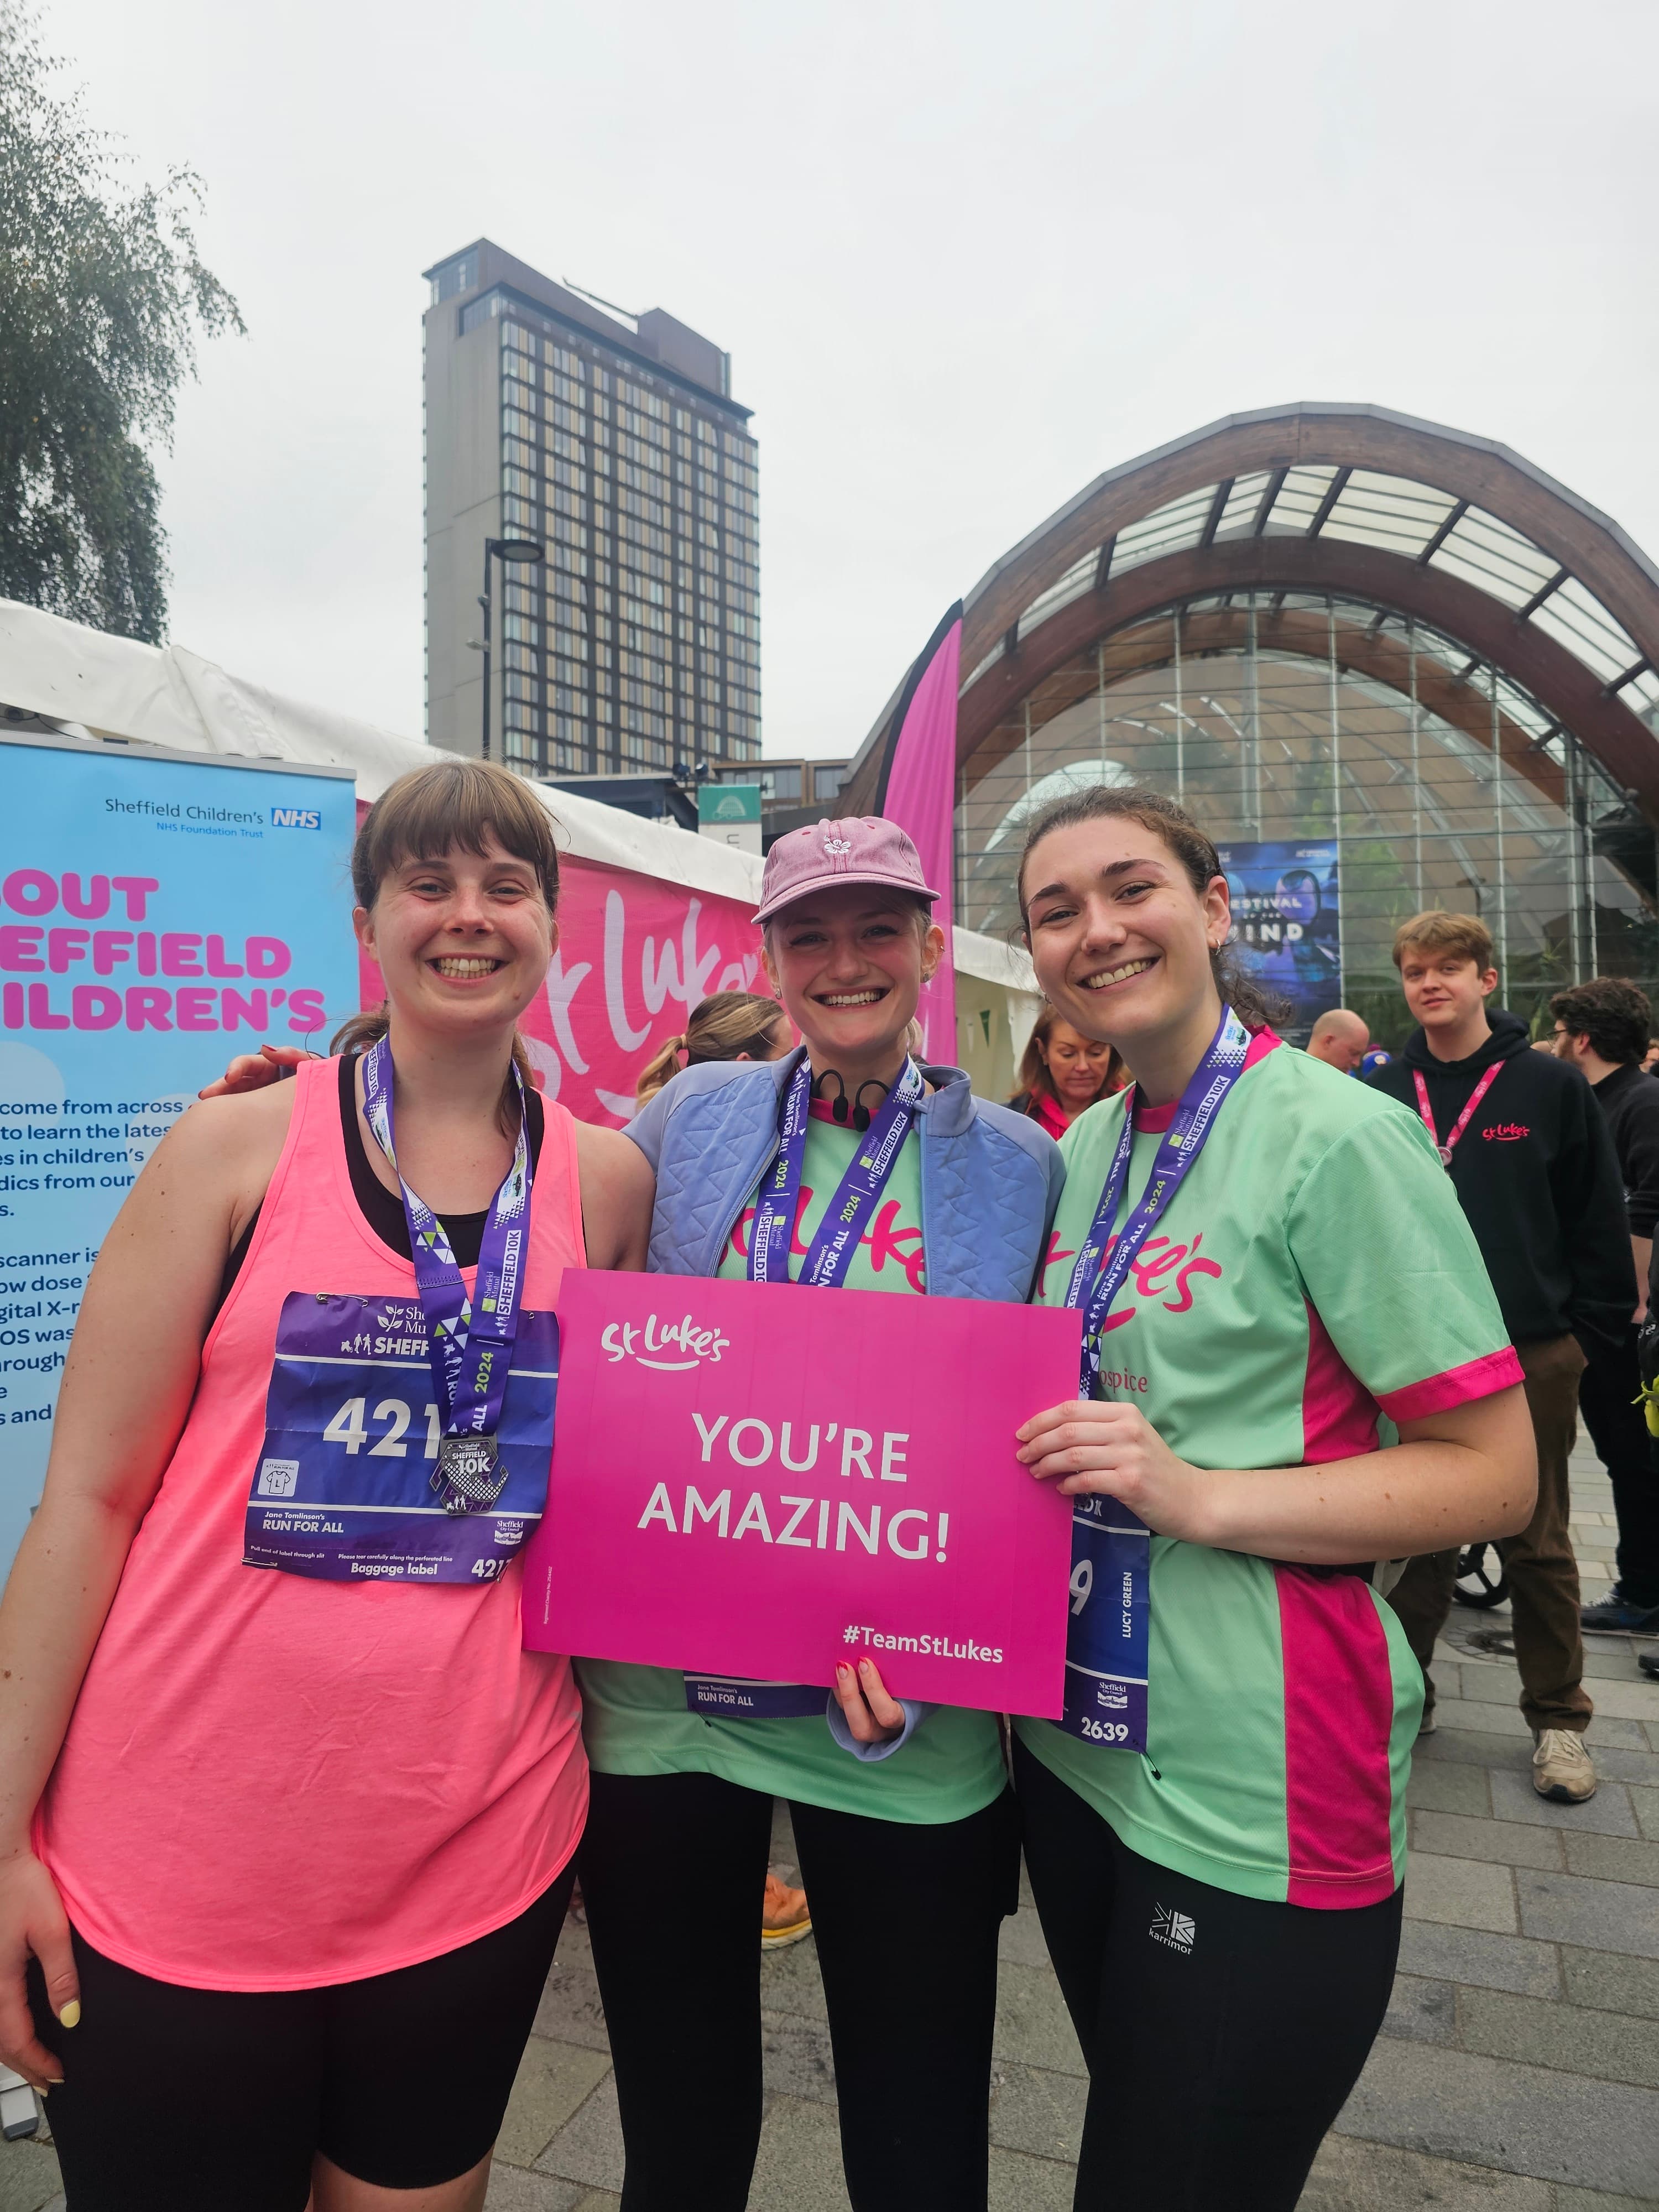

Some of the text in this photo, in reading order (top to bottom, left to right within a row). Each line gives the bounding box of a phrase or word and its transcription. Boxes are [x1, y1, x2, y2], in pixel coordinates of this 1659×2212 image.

[106, 799, 264, 825] Sheffield Children's
[273, 810, 320, 829] NHS
[156, 822, 264, 839] NHS Foundation Trust
[3, 982, 326, 1032] ILDREN'S
[0, 1099, 183, 1115] come from across
[1183, 1078, 1229, 1149] SHEFFIELD 10K
[1, 1126, 22, 1140] to
[28, 1124, 81, 1139] learn
[86, 1124, 120, 1138] the
[792, 1104, 801, 1136] Tomlinson's
[1174, 1109, 1190, 1134] Sheffield
[1180, 1115, 1194, 1136] Mutual
[1496, 1123, 1530, 1138] Luke's
[774, 1093, 797, 1189] RUN FOR ALL 2024
[864, 1136, 878, 1157] Sheffield
[870, 1142, 881, 1160] Mutual
[874, 1114, 906, 1173] SHEFFIELD 10K
[20, 1149, 38, 1165] in
[43, 1148, 144, 1164] children's
[44, 1174, 95, 1189] from
[100, 1175, 135, 1188] our
[1110, 1162, 1120, 1181] ALL
[839, 1195, 861, 1223] 2024
[1144, 1180, 1166, 1214] 2024
[756, 1218, 770, 1270] SHEFFIELD
[769, 1226, 778, 1246] Mutual
[775, 1225, 784, 1249] Sheffield
[832, 1230, 850, 1251] ALL
[499, 1232, 519, 1314] SHEFFIELD 10K
[810, 1244, 829, 1283] Tomlinson's
[821, 1251, 840, 1277] FOR
[1097, 1240, 1126, 1298] Jane Tomlinson's
[1100, 1222, 1147, 1301] RUN FOR ALL
[31, 1275, 82, 1291] dose
[484, 1272, 494, 1298] Sheffield
[491, 1276, 500, 1298] Mutual
[1070, 1251, 1088, 1302] SHEFFIELD
[1, 1328, 75, 1345] OS was
[601, 1314, 730, 1361] St Luke's
[472, 1352, 494, 1432] ALL 2024
[11, 1404, 51, 1423] and
[452, 1451, 487, 1459] SHEFFIELD
[692, 1412, 910, 1483] YOU'RE
[457, 1457, 491, 1474] 10K
[263, 1520, 344, 1533] RUN FOR ALL
[284, 1512, 325, 1520] Tomlinson's
[637, 1482, 950, 1563] AMAZING!
[351, 1563, 437, 1576] Baggage label
[1122, 1572, 1133, 1638] LUCY GREEN
[843, 1625, 1003, 1663] #TeamStLukes
[698, 1692, 754, 1706] RUN FOR ALL
[711, 1686, 737, 1694] Tomlinson's
[1099, 1682, 1126, 1692] Sheffield
[1081, 1717, 1129, 1741] 2639
[1149, 1927, 1192, 1955] karrimor
